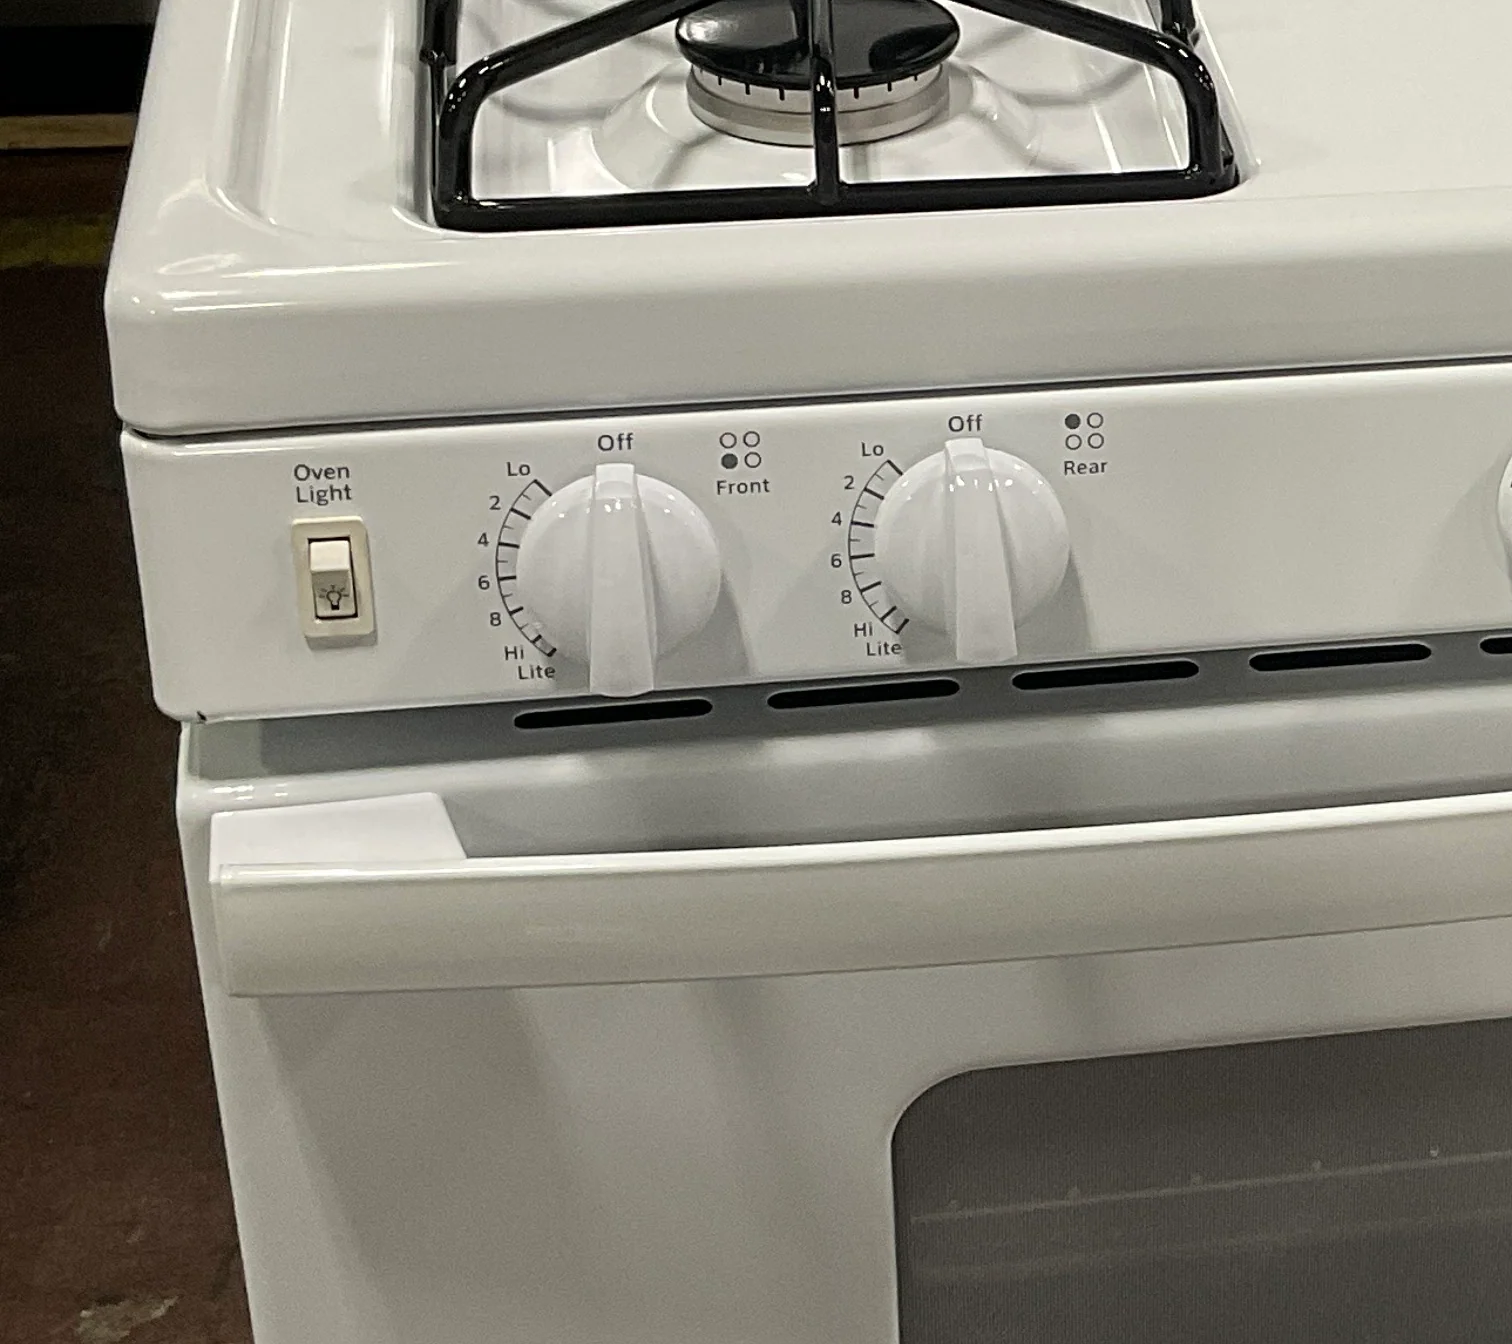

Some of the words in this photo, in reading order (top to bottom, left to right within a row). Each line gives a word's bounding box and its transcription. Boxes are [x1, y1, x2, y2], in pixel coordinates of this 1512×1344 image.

[948, 414, 983, 433] Off
[597, 432, 634, 452] Off
[861, 442, 884, 457] Lo
[294, 464, 350, 482] Oven
[507, 462, 531, 478] Lo
[1064, 459, 1107, 476] Rear
[716, 478, 770, 496] Front
[844, 475, 855, 490] 2
[296, 484, 352, 506] Light
[489, 496, 501, 511] 2
[831, 512, 843, 527] 4
[477, 532, 489, 547] 4
[831, 554, 843, 568] 6
[478, 575, 490, 590] 6
[841, 590, 852, 605] 8
[490, 612, 502, 627] 8
[854, 622, 873, 637] Hi
[504, 645, 525, 661] Hi
[866, 641, 902, 657] Lite
[518, 664, 556, 680] Lite
